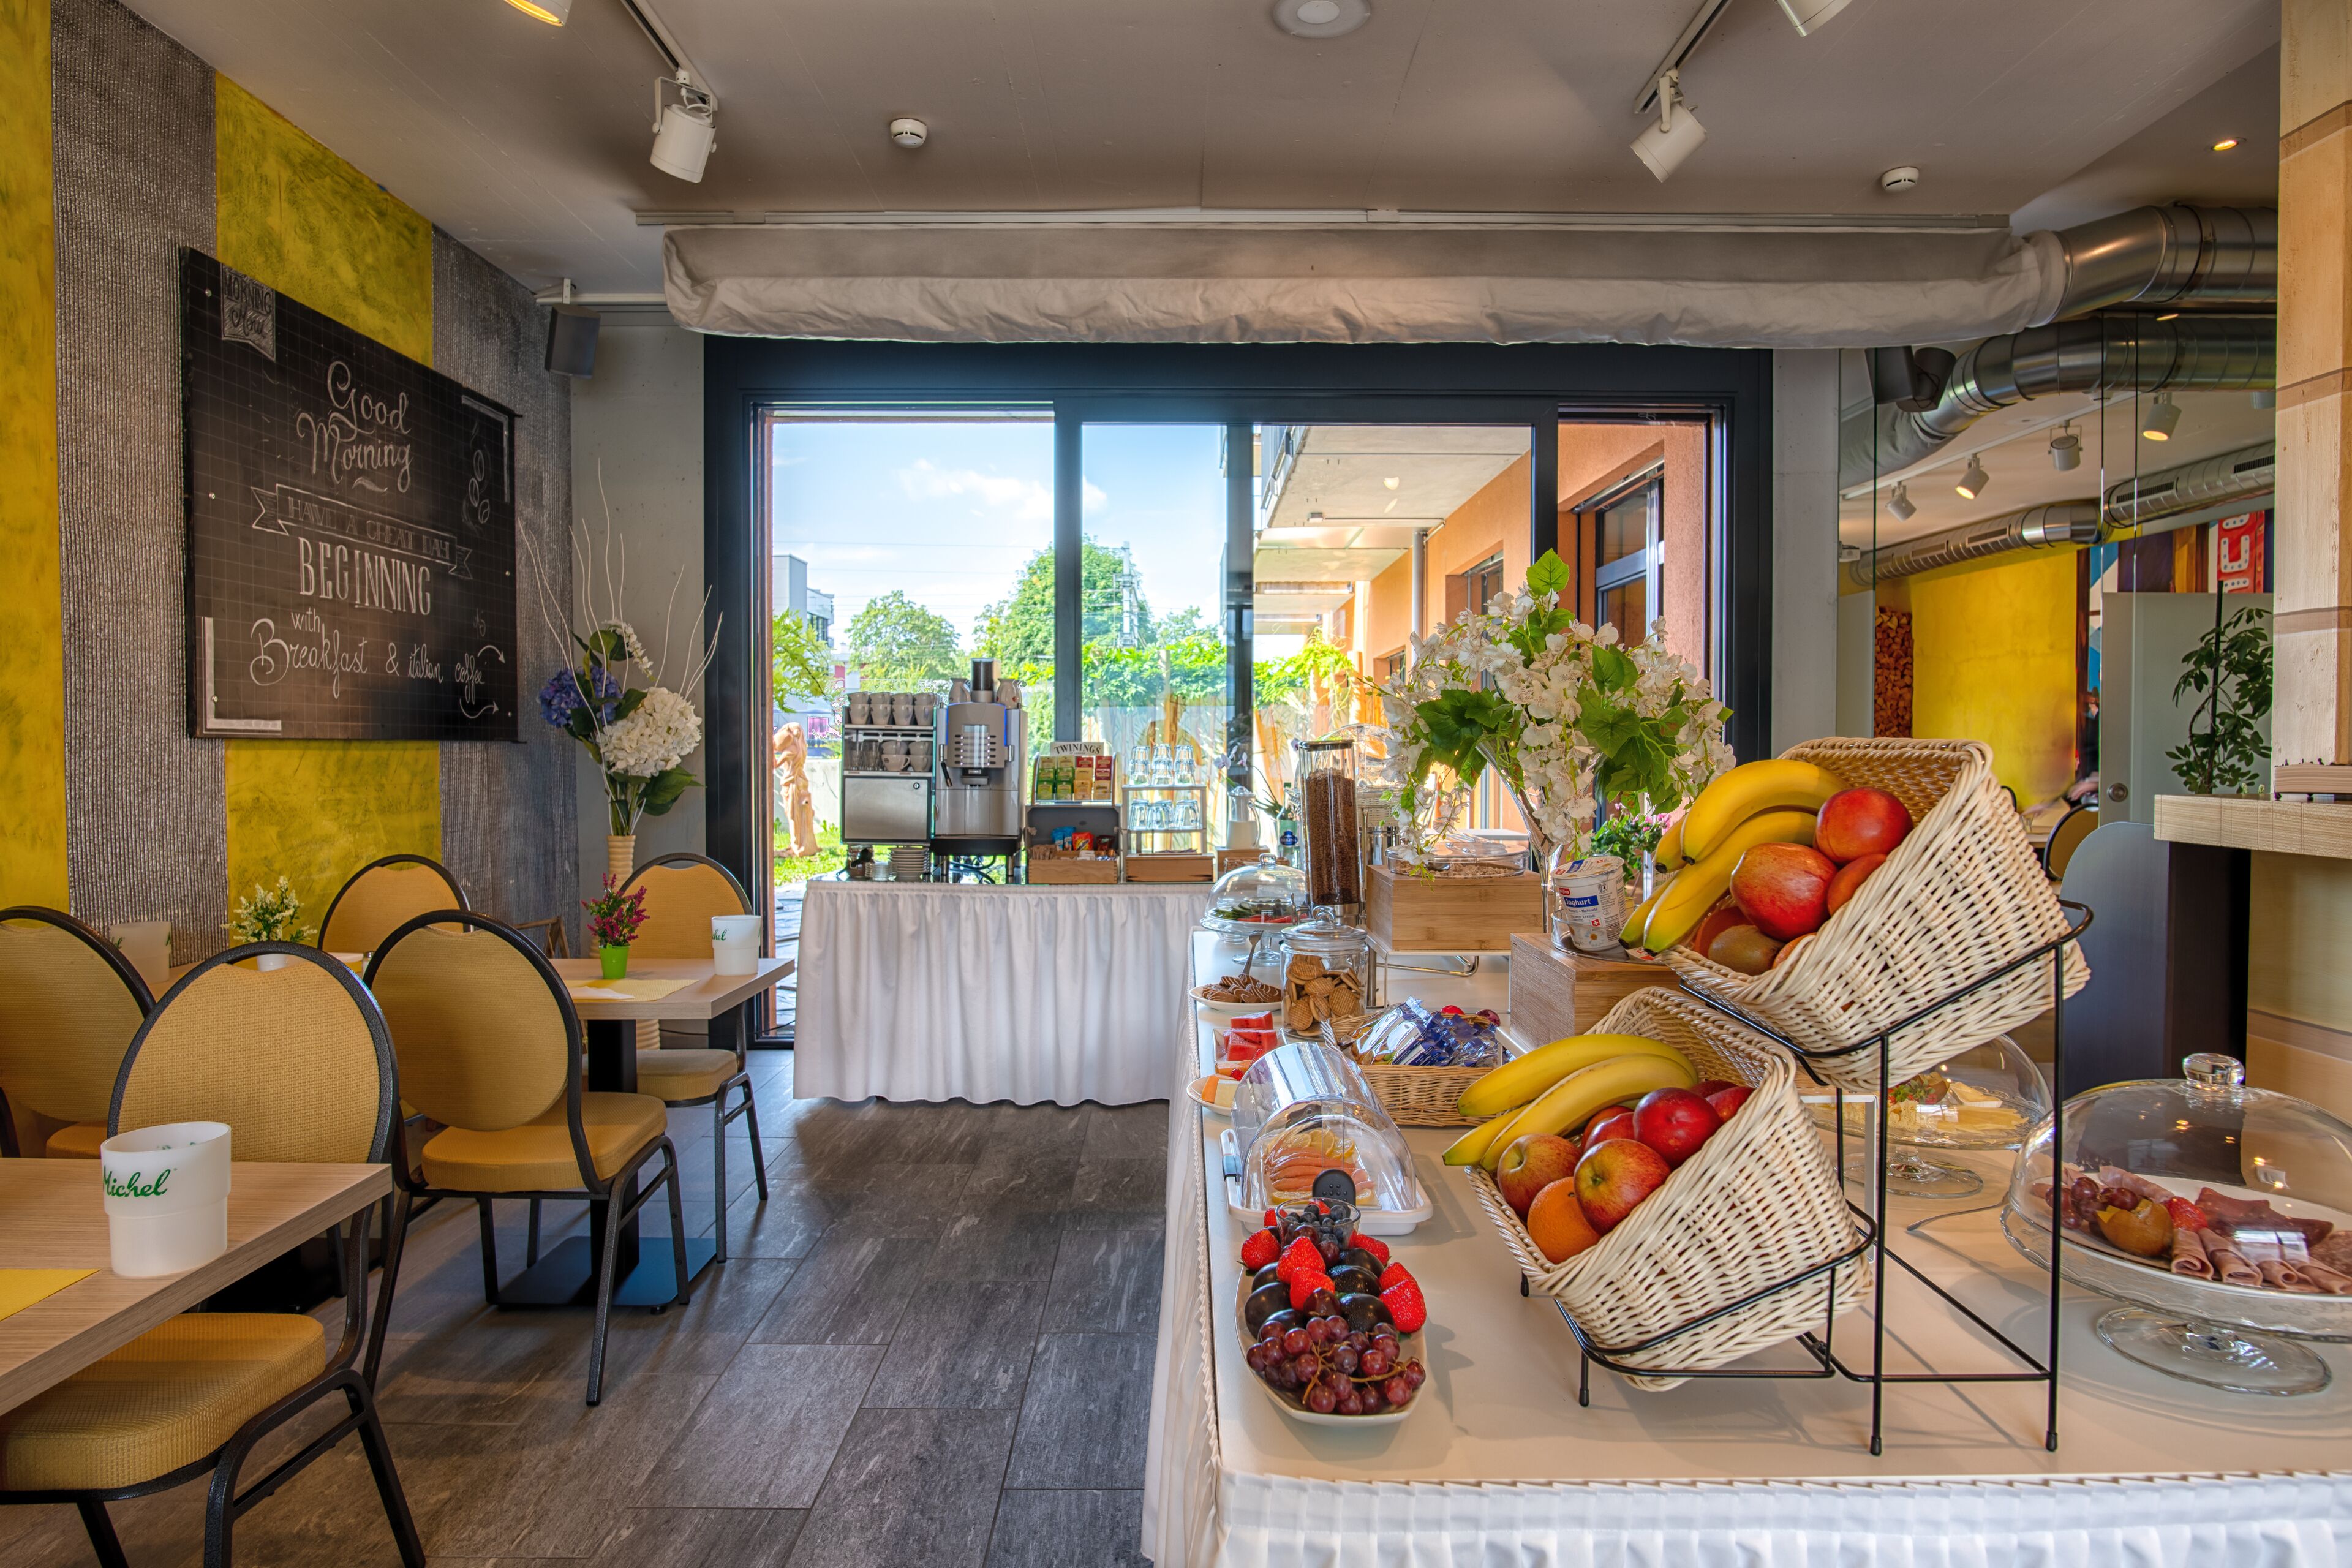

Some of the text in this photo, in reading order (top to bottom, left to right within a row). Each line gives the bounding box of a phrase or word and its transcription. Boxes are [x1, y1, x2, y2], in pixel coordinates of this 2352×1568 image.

[223, 270, 271, 314] MORNING
[232, 304, 267, 338] Menu
[327, 361, 412, 442] Good
[296, 412, 413, 493] Morning
[288, 496, 450, 560] HAVE A GREAT DAY
[298, 537, 431, 615] BEGINNING
[291, 607, 320, 633] with
[250, 617, 486, 704] Breakfast & italian coffee
[1054, 743, 1101, 755] TWININGS
[1566, 898, 1592, 907] Joghurt
[103, 1165, 171, 1197] Michel
